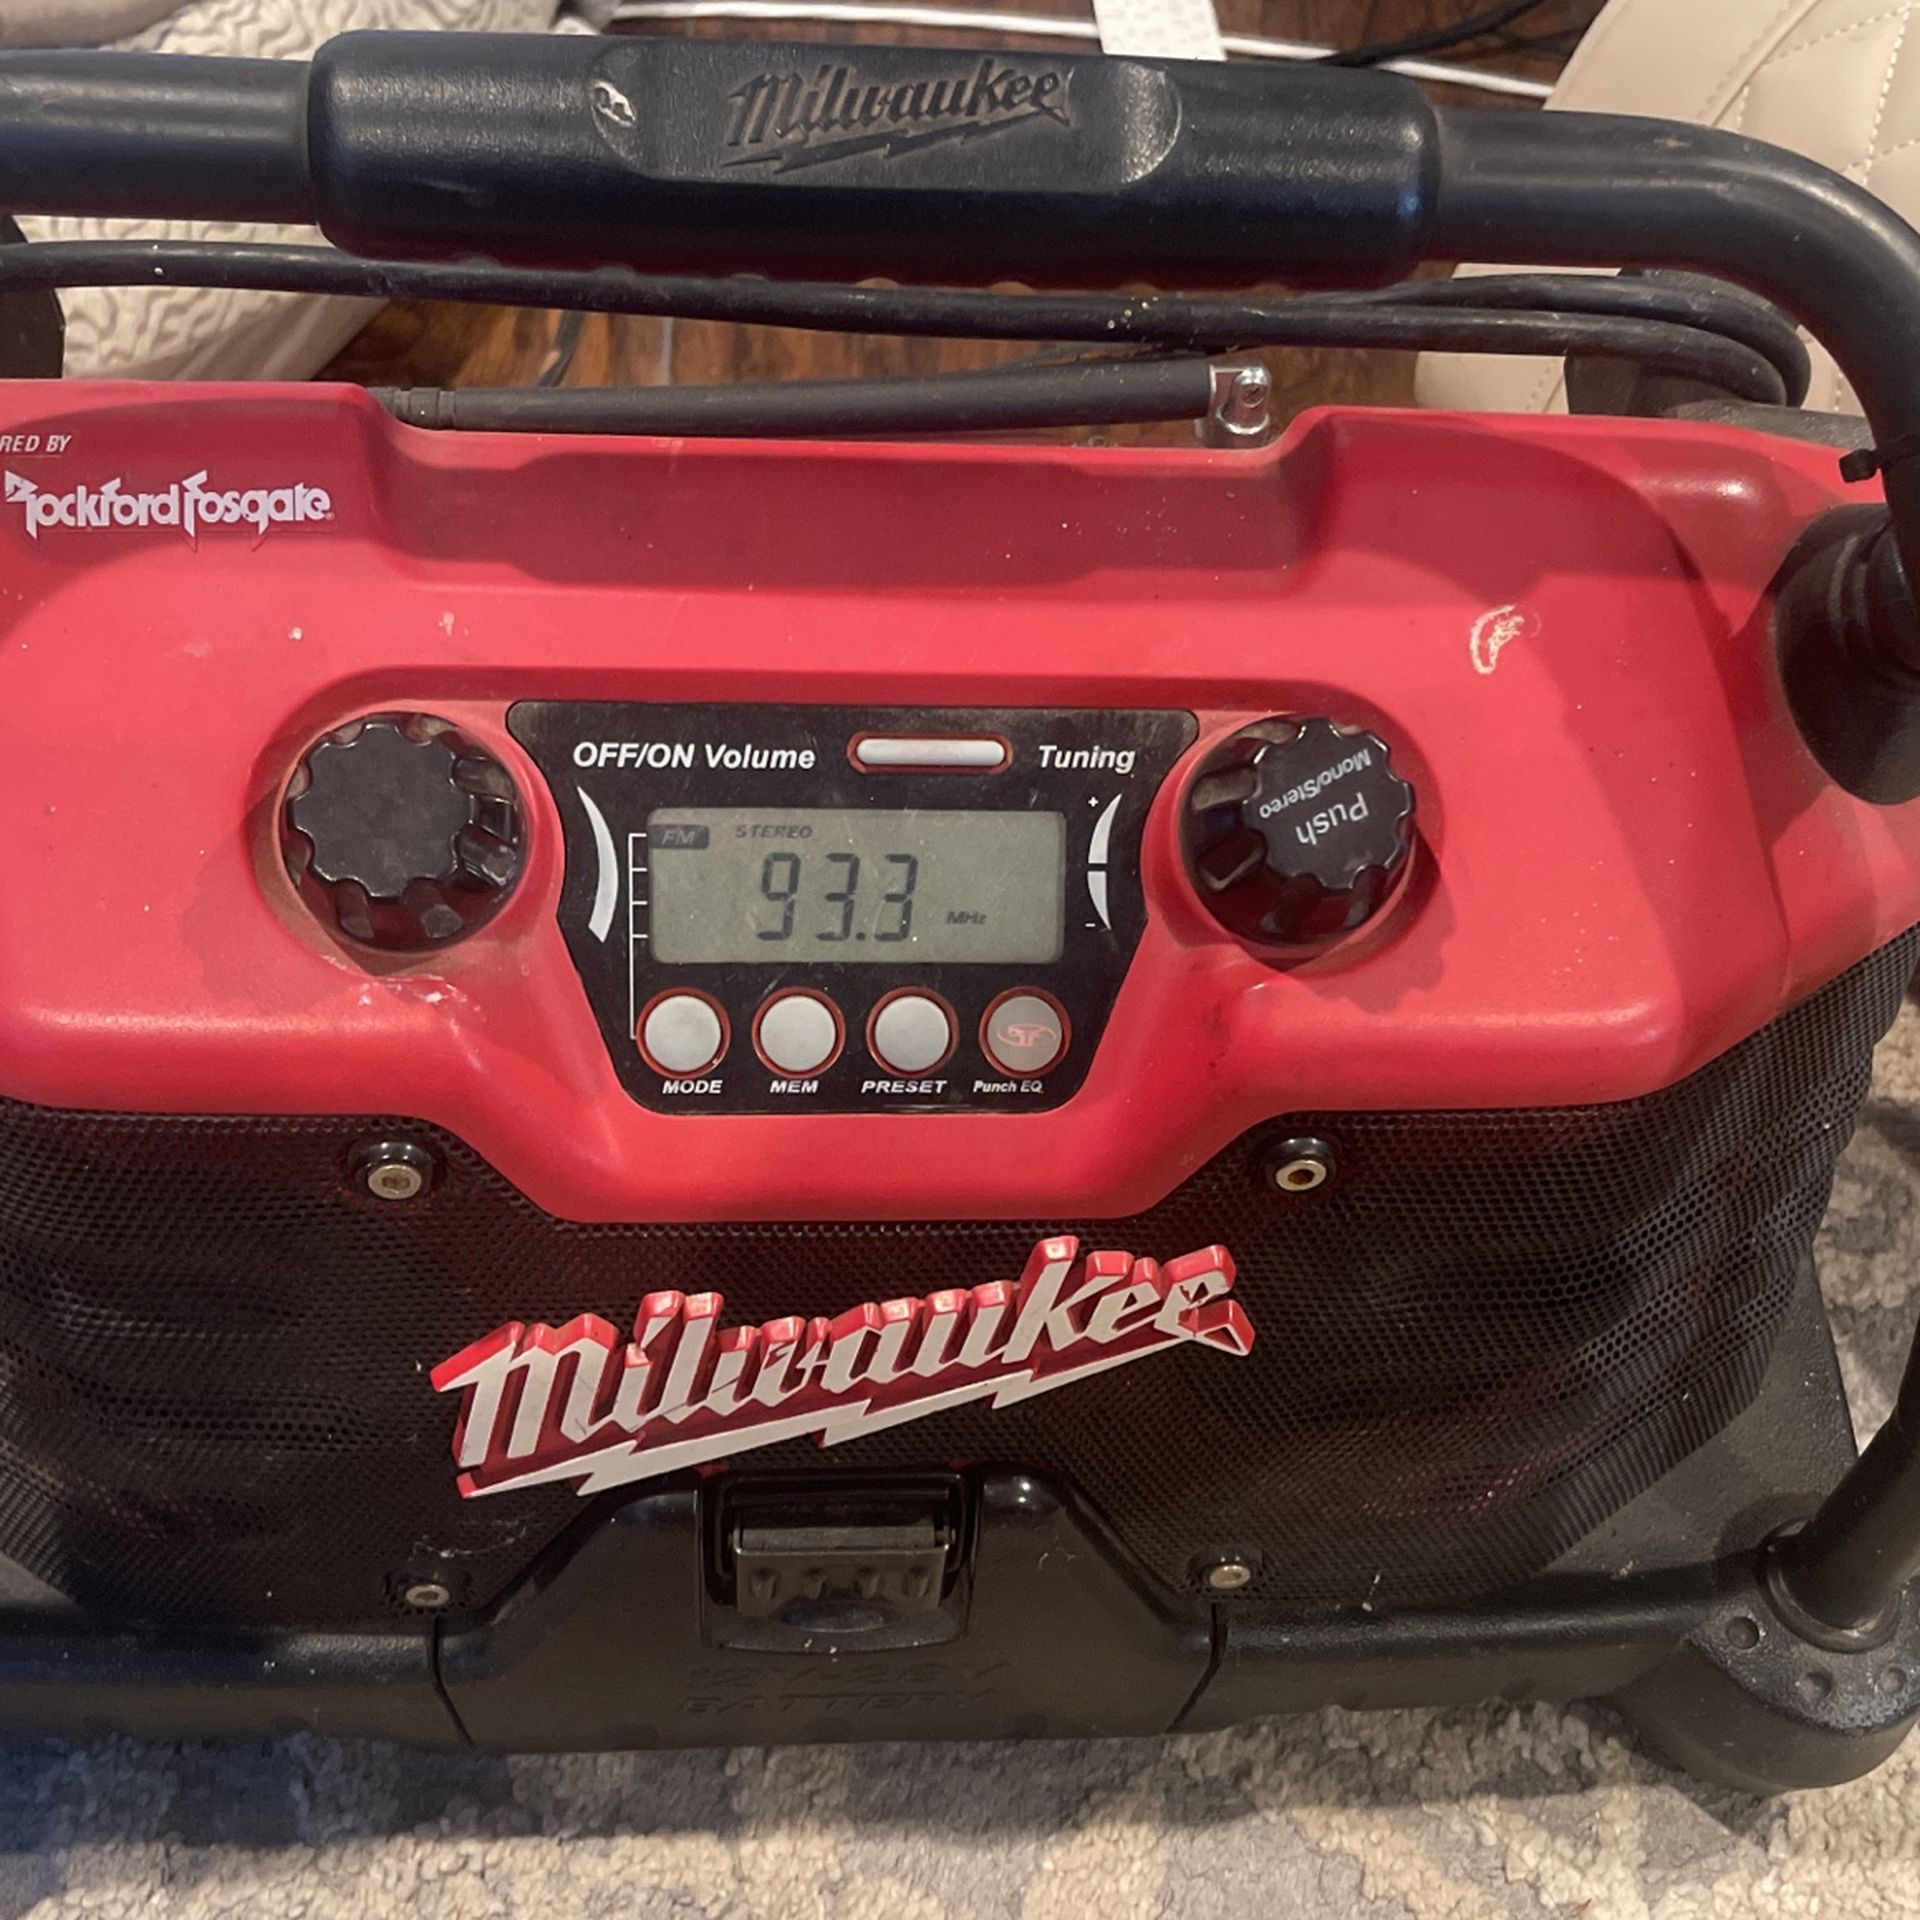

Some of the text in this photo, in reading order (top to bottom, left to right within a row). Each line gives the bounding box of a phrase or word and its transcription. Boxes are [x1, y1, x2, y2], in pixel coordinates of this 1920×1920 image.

[728, 58, 1071, 147] Milwaukee
[46, 435, 72, 452] BY
[4, 470, 180, 540] Rockford
[572, 742, 816, 769] OFF/ON Volume
[1038, 745, 1135, 774] Tuning
[1259, 748, 1372, 818] Mono/Stereo
[735, 824, 813, 840] STEREO
[1295, 793, 1369, 846] Push
[661, 830, 696, 846] FM
[757, 852, 987, 942] 93.3 MHz
[662, 1079, 723, 1095] MODE
[769, 1079, 819, 1094] MEM
[861, 1079, 947, 1094] PRESET
[973, 1079, 1044, 1094] Punch EQ
[430, 1235, 1256, 1472] Milwaukee
